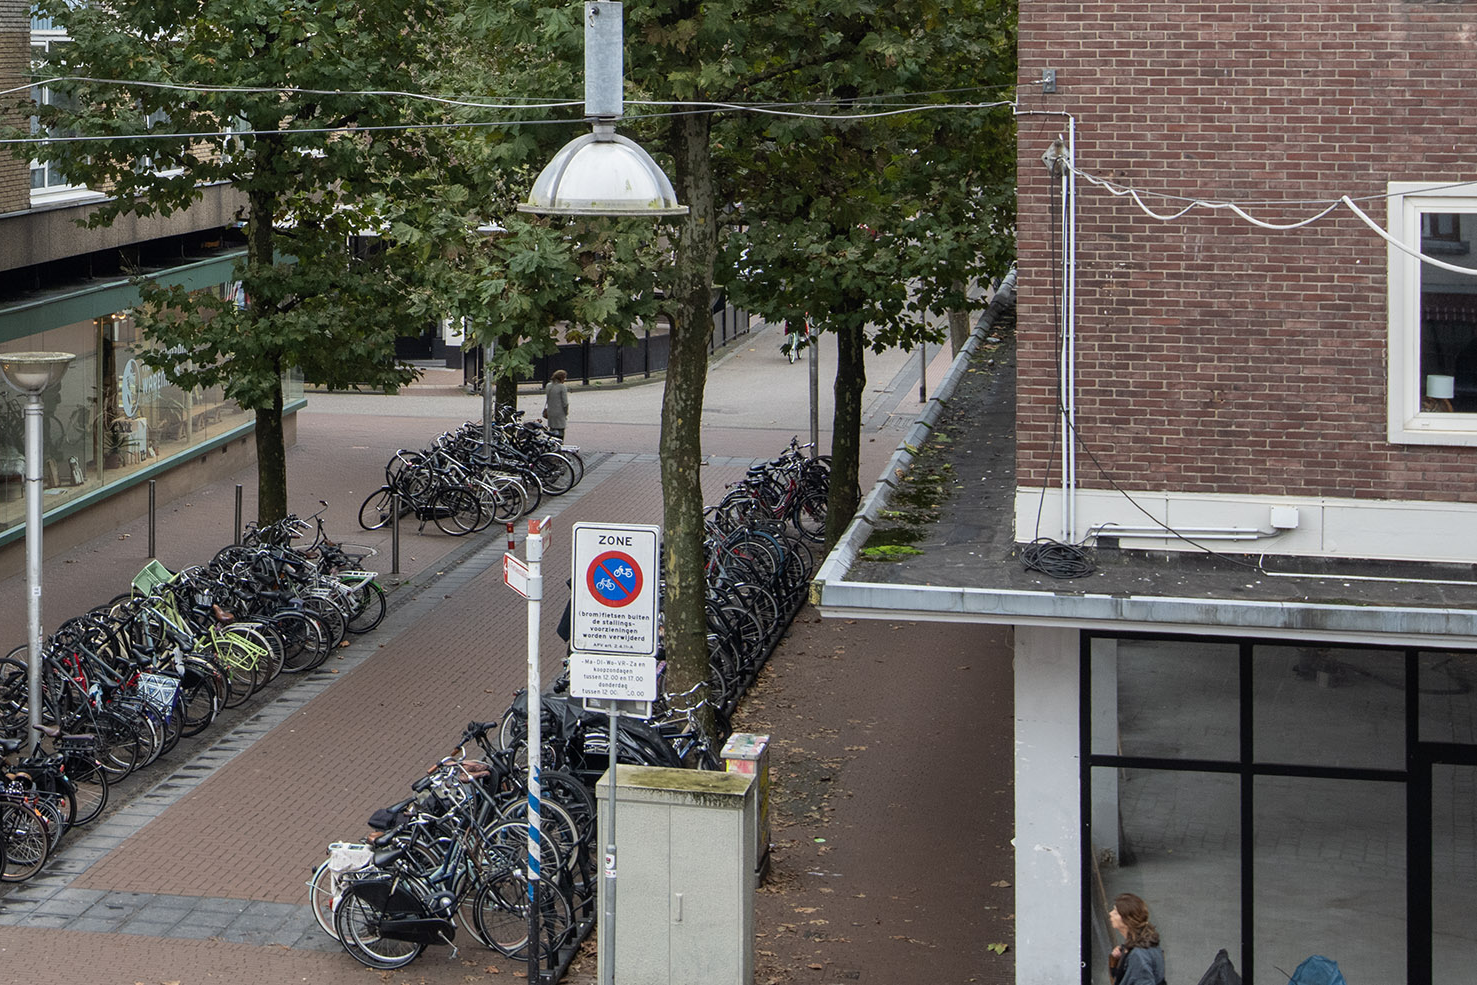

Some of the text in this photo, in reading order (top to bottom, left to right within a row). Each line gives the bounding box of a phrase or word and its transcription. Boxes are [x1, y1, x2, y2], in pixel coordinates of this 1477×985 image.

[598, 535, 632, 546] ZONE
[578, 611, 626, 619] (brom)fietsen
[590, 626, 638, 634] voorzieningen
